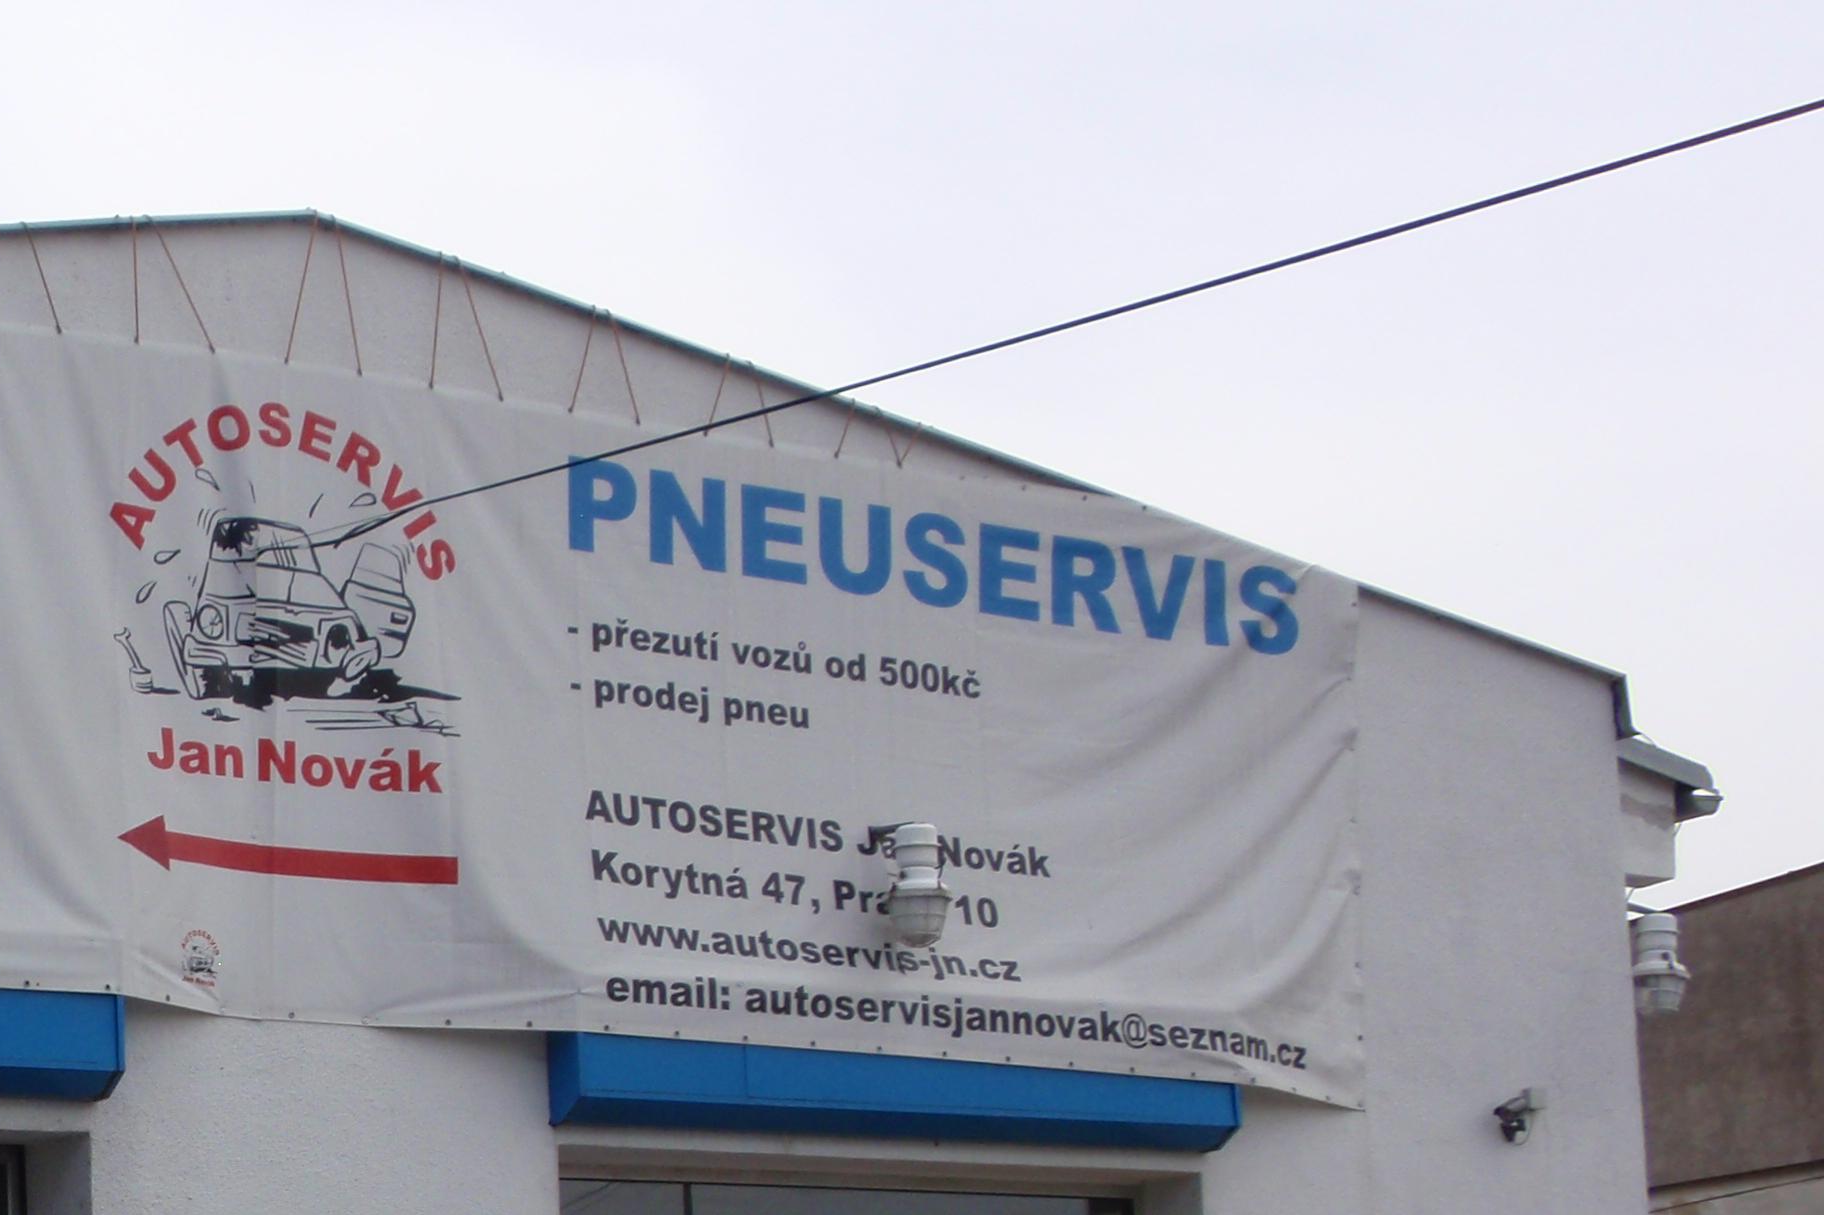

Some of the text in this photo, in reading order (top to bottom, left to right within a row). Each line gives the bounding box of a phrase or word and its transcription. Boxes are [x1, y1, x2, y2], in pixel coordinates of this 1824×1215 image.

[109, 402, 456, 581] AUTOSERVIS
[567, 455, 1301, 655] PNEUSERVIS
[593, 619, 718, 661] přezutí
[732, 642, 811, 674] vozů
[826, 654, 865, 681] od
[880, 657, 980, 698] 500kč
[595, 680, 708, 723] prodej
[724, 698, 808, 728] pneu
[148, 728, 443, 794] Jan Novák
[586, 789, 844, 853] AUTOSERVIS
[936, 835, 1051, 878] Novák
[592, 850, 747, 899] Korytná
[762, 873, 820, 914] 47,
[955, 896, 998, 927] 10
[597, 914, 1022, 983] www.autoservis-jn.cz
[606, 977, 1307, 1069] email: autoservisjannovak@seznam.cz
